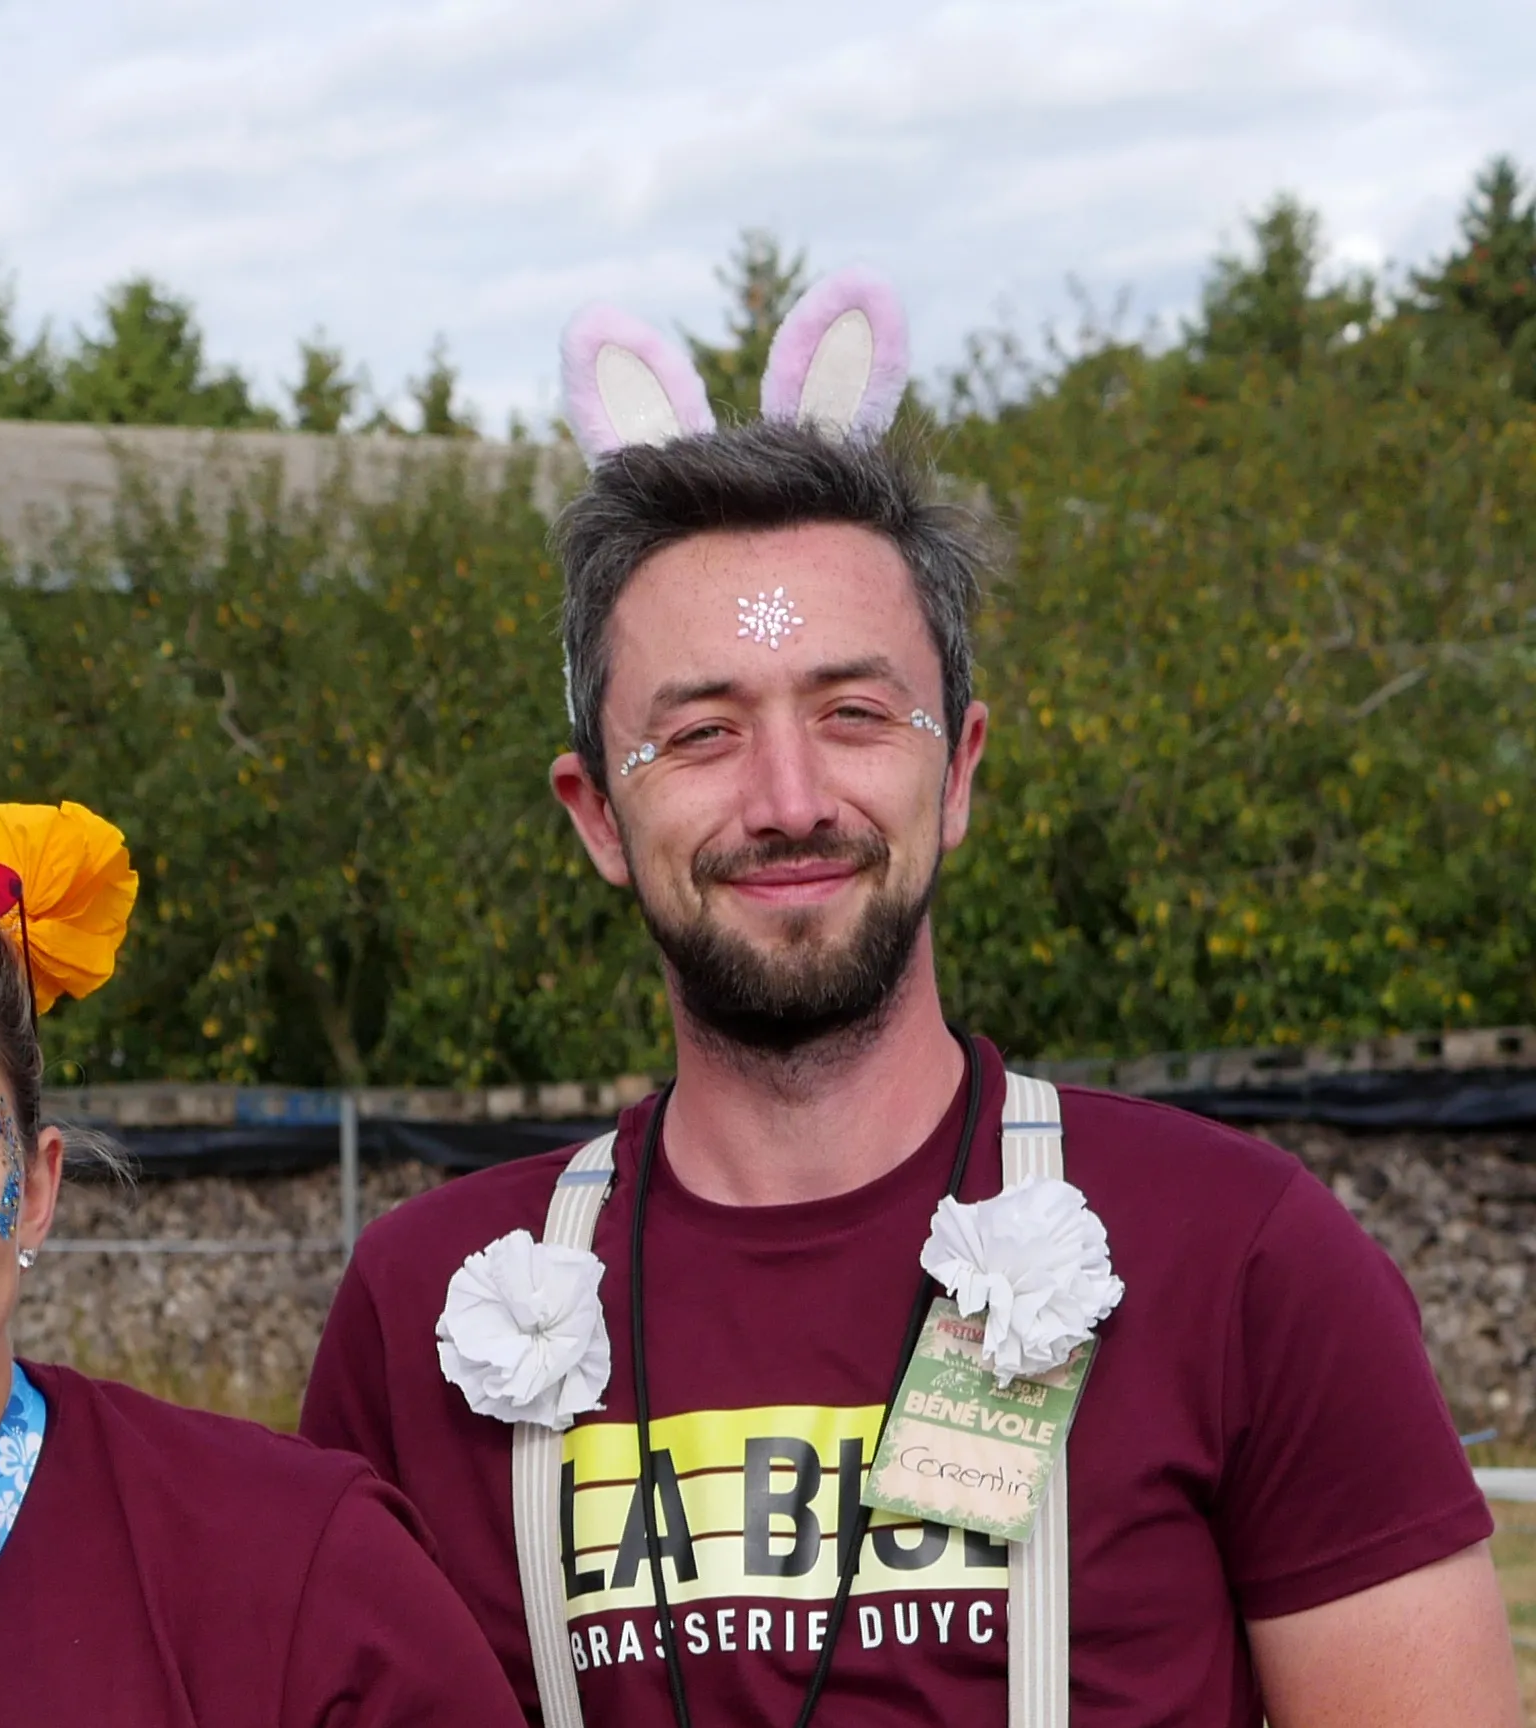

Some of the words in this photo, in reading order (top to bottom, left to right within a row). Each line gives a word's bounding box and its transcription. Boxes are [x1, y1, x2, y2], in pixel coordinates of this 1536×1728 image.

[936, 1319, 985, 1340] FESTIV
[903, 1389, 1057, 1446] BÉNÉVOLE
[860, 1600, 1008, 1649] DUYC
